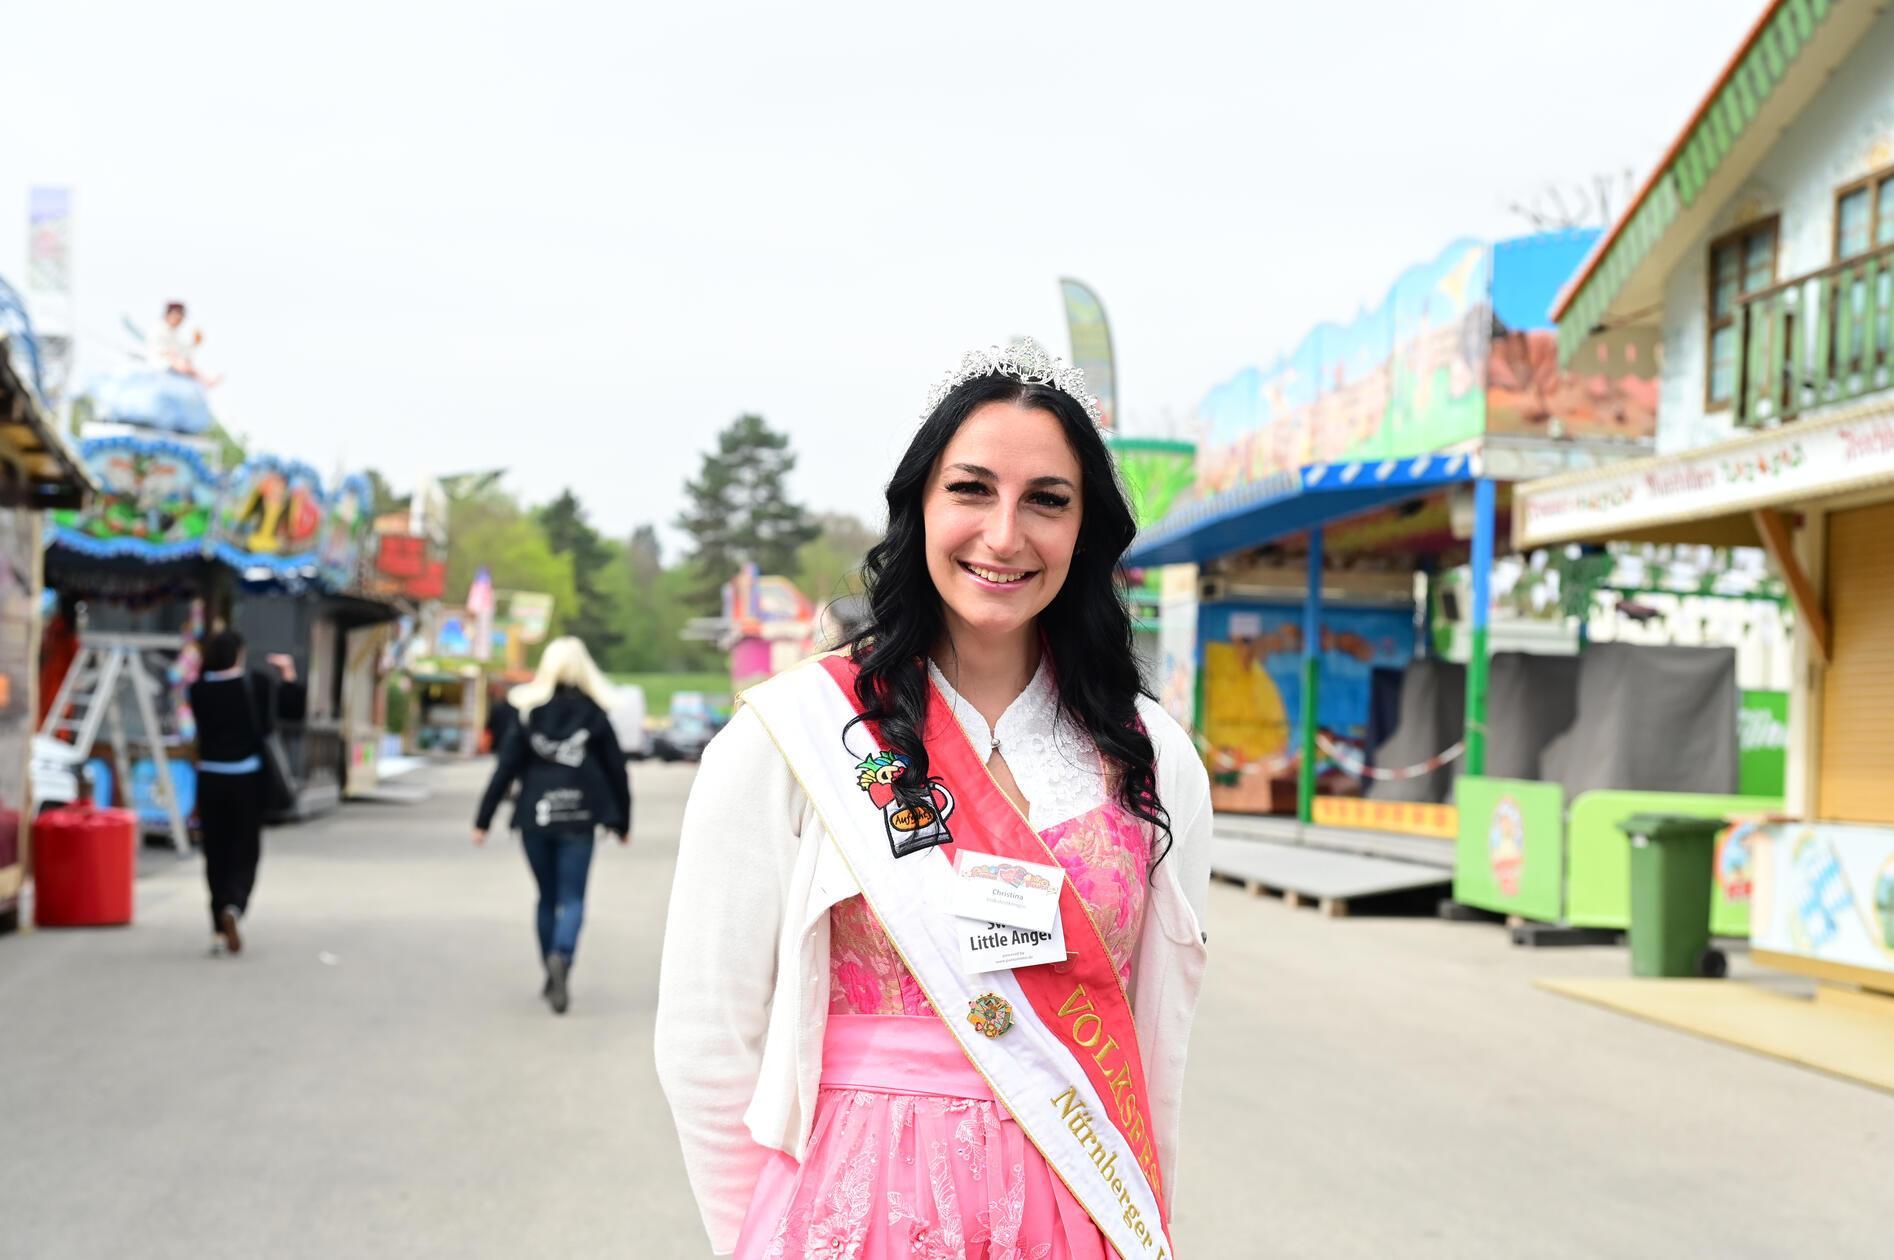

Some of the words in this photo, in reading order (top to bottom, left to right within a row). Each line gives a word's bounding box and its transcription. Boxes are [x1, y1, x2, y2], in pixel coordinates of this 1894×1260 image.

[992, 888, 1024, 901] Christina
[970, 932, 1008, 951] Little
[1057, 983, 1162, 1202] VOLKSFES
[1050, 1085, 1153, 1251] Nürnberger
